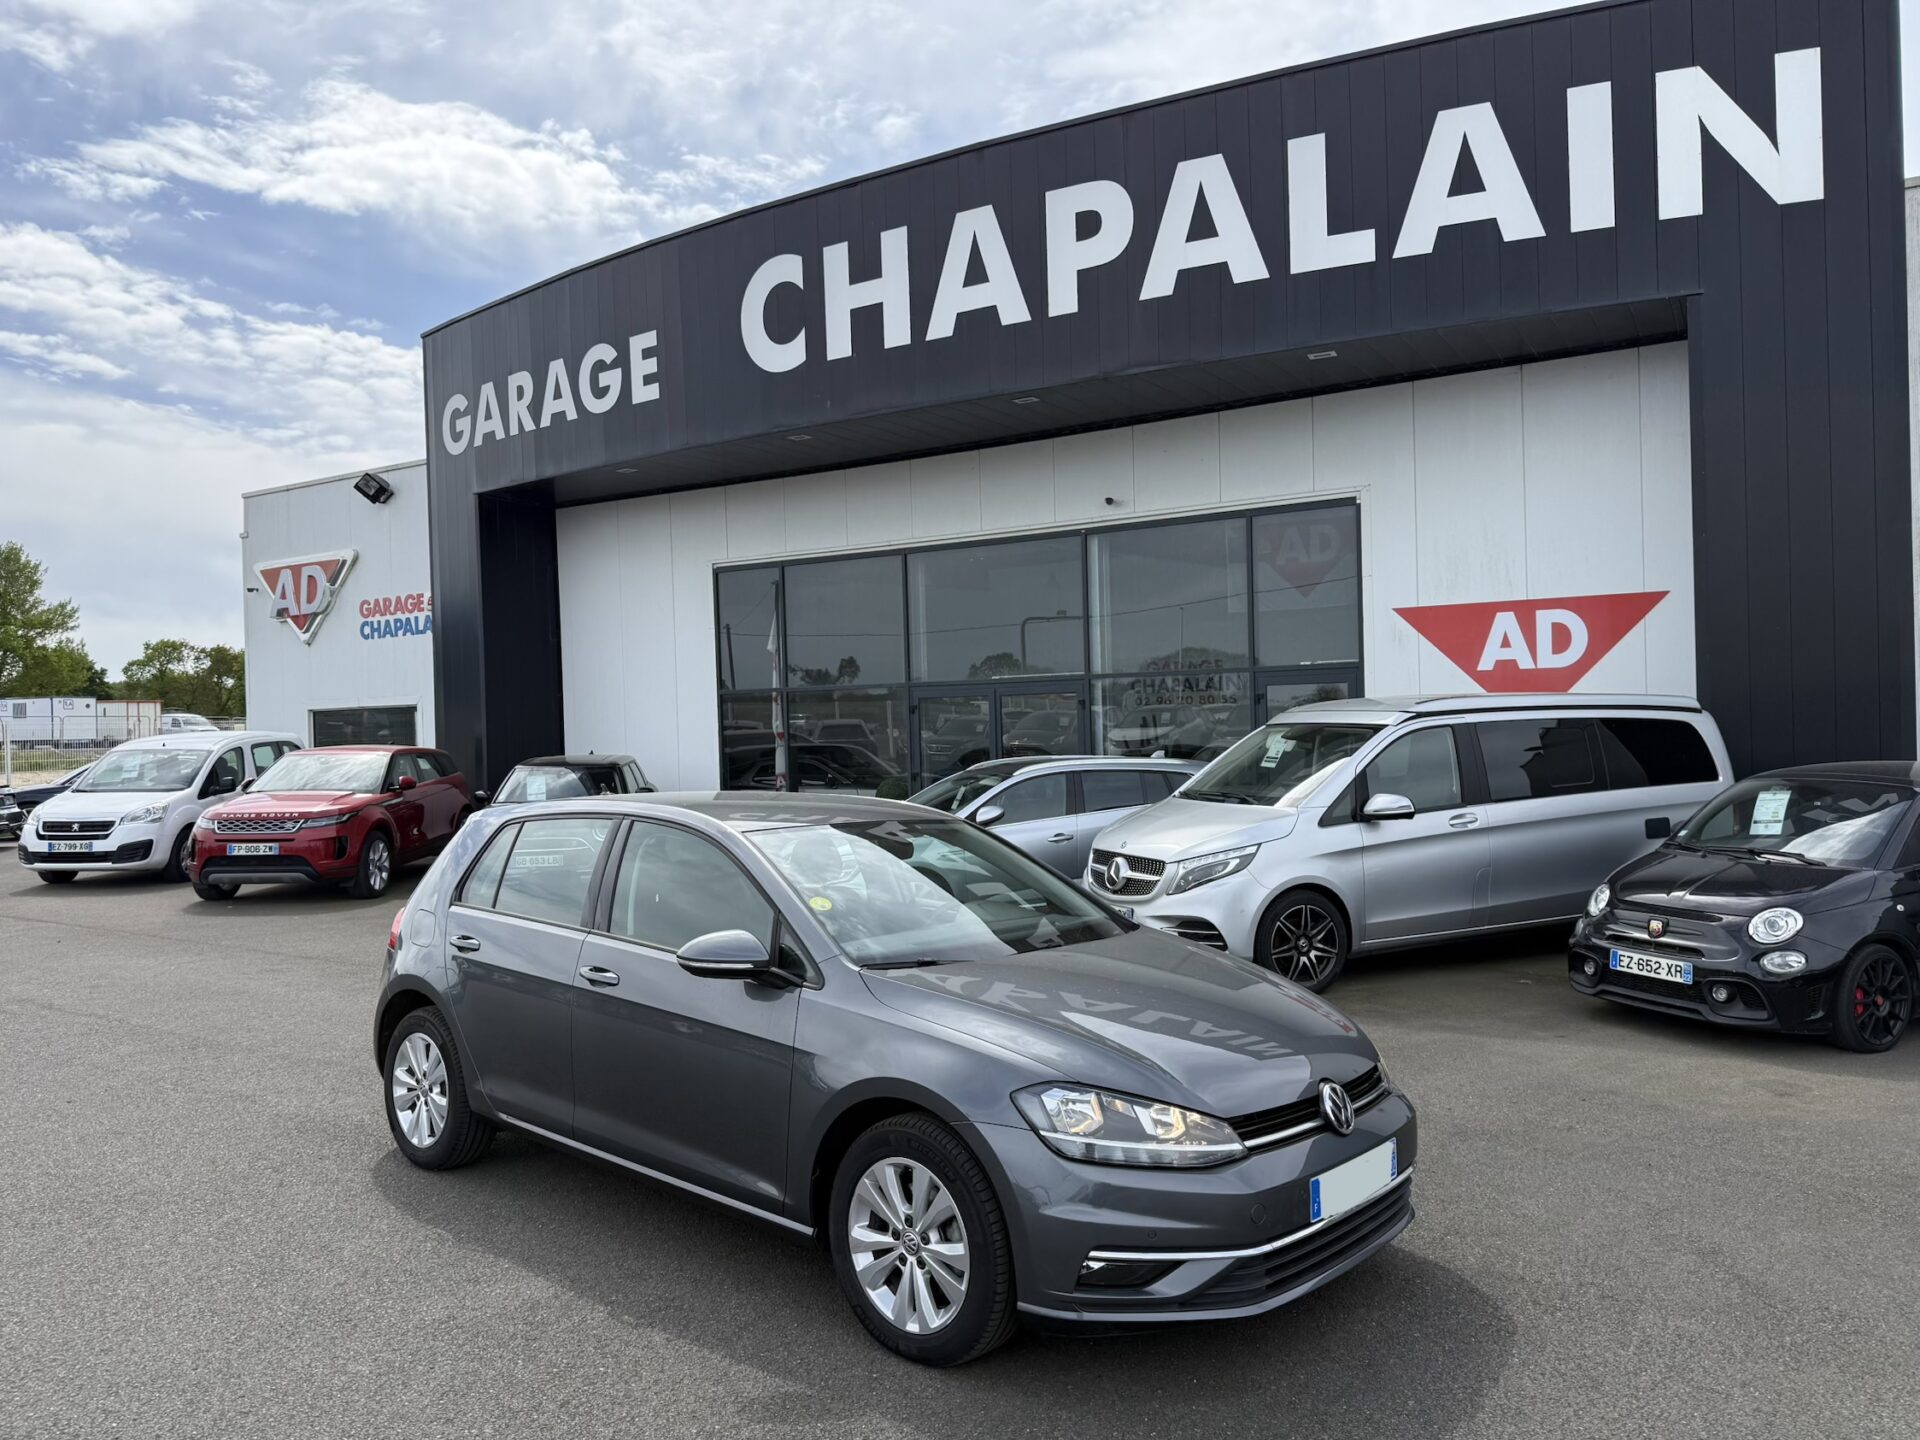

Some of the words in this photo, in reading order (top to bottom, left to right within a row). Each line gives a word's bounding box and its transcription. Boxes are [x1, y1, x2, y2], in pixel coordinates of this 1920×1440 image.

[441, 329, 661, 457] GARAGE
[740, 46, 1826, 373] CHAPALAIN
[270, 564, 333, 620] AD
[359, 593, 425, 619] GARAGE
[1476, 608, 1590, 672] AD
[1618, 953, 1683, 979] EZ-652-XR
